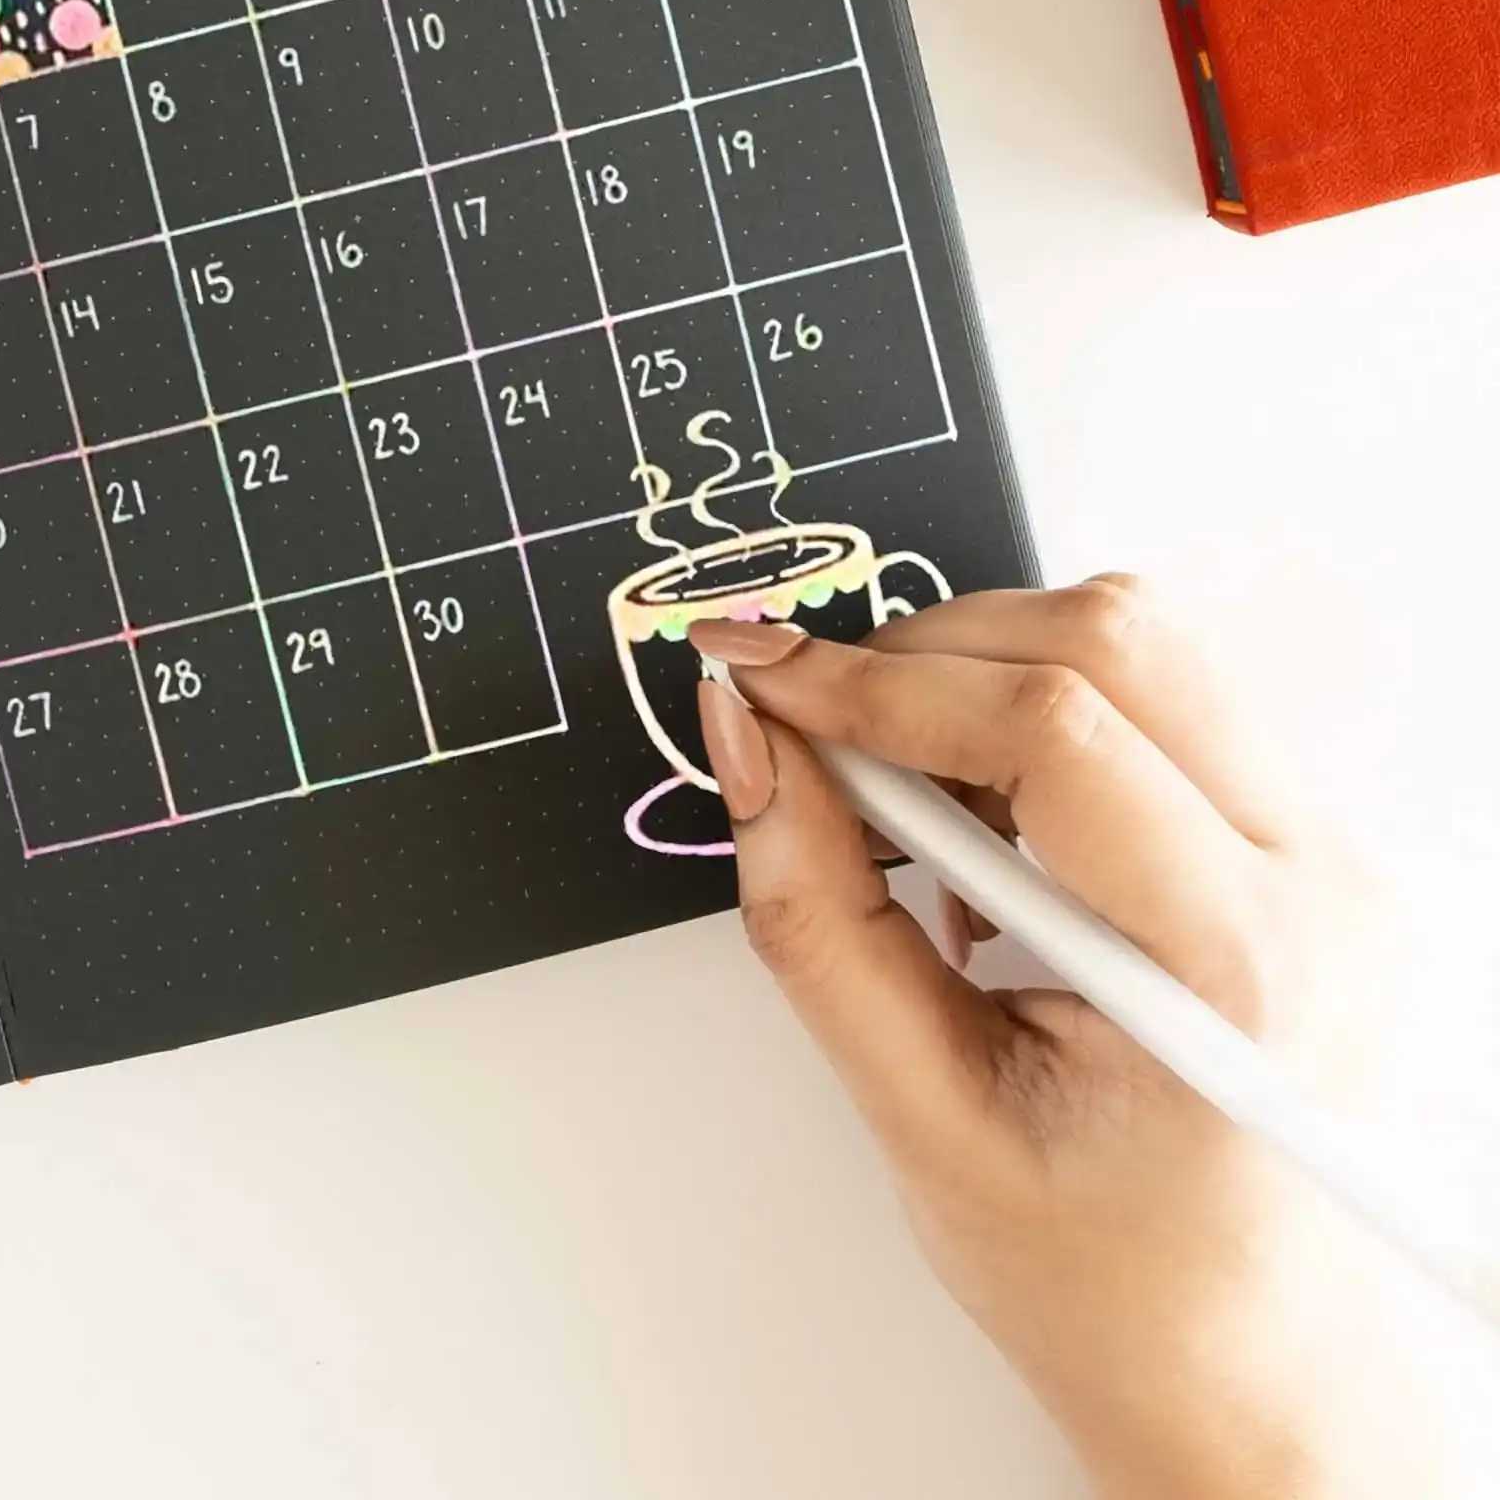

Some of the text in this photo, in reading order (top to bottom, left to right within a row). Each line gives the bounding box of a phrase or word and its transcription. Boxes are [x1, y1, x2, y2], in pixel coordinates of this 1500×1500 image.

[15, 114, 39, 150] 7
[148, 80, 177, 123] 8
[278, 47, 304, 86] 9
[406, 12, 446, 53] 10
[60, 294, 100, 338] 14
[190, 261, 234, 305] 15
[320, 230, 364, 274] 16
[452, 195, 487, 240] 17
[585, 164, 629, 207] 18
[717, 129, 756, 176] 19
[106, 479, 146, 524] 21
[238, 444, 289, 491] 22
[367, 411, 421, 460] 23
[499, 379, 551, 427] 24
[630, 348, 688, 399] 25
[762, 312, 824, 363] 26
[6, 597, 464, 738] 27 28 29 30
